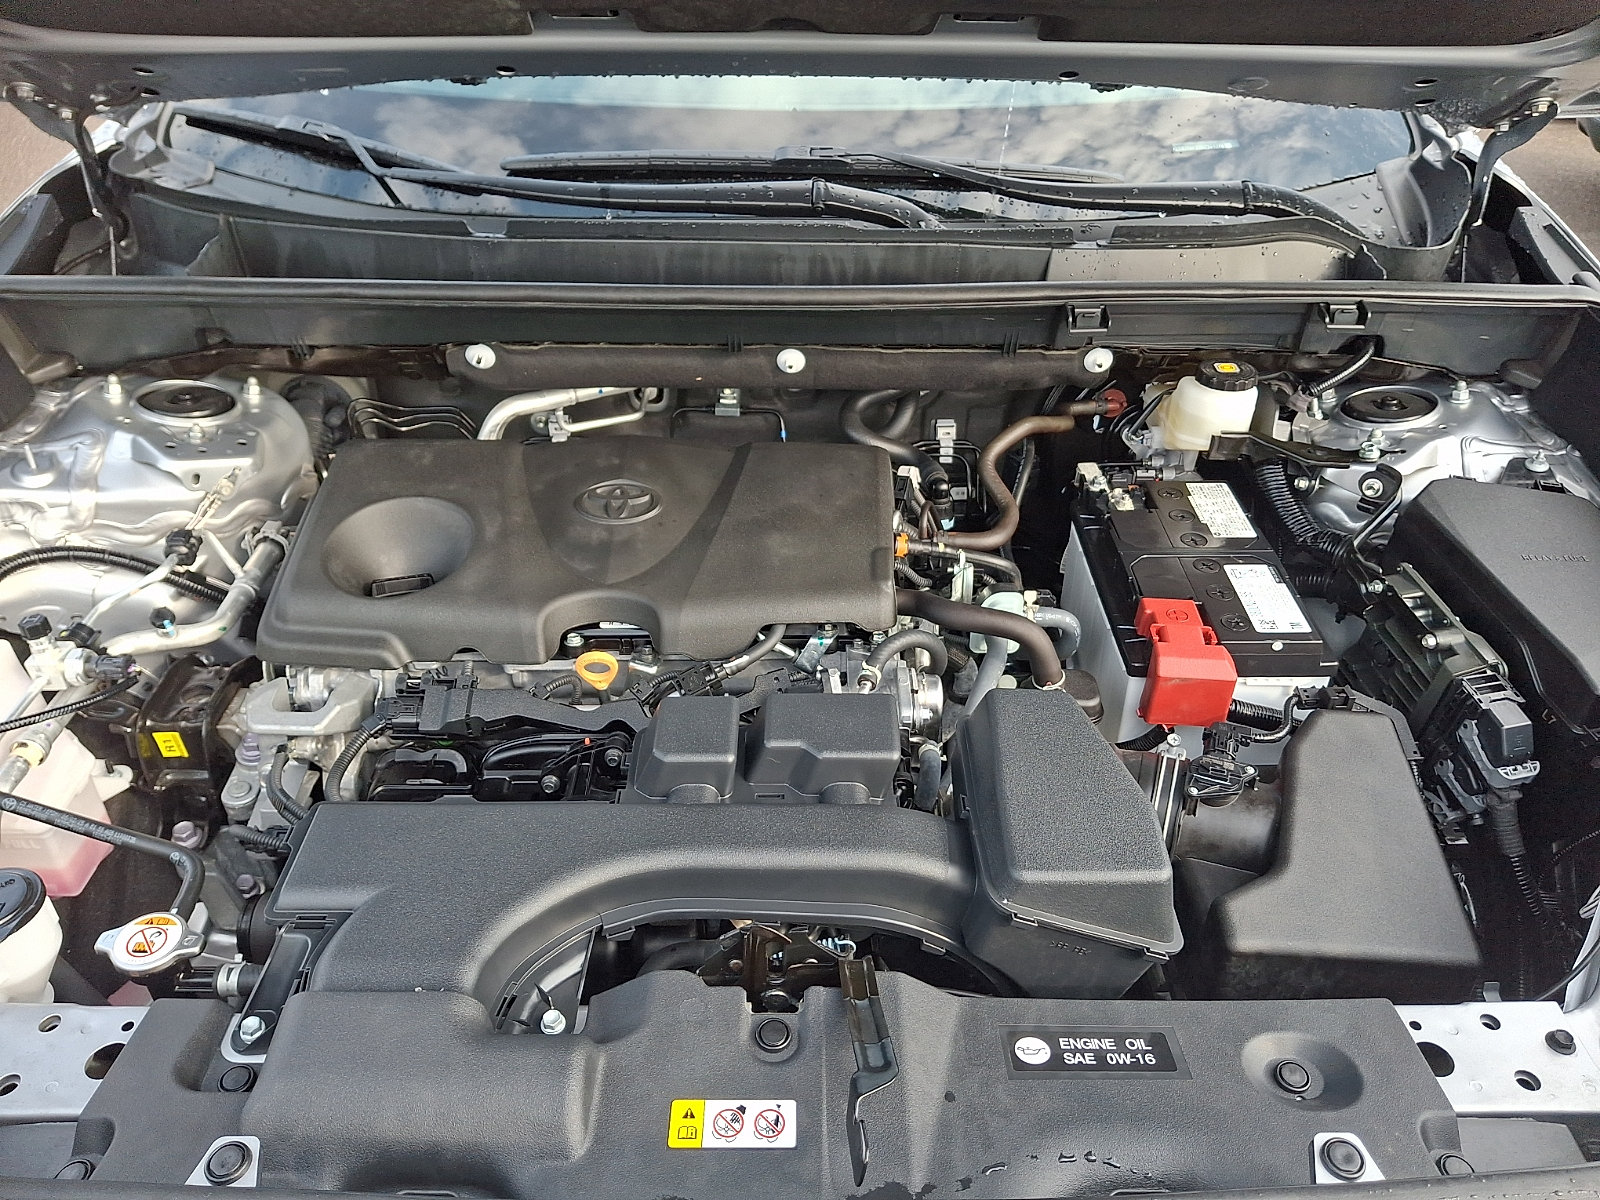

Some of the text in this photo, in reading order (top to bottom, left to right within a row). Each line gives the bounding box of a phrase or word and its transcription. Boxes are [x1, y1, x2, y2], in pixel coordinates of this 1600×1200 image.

[1058, 1037, 1153, 1051] ENGINE OIL
[1063, 1052, 1157, 1066] SAE 0W-16
